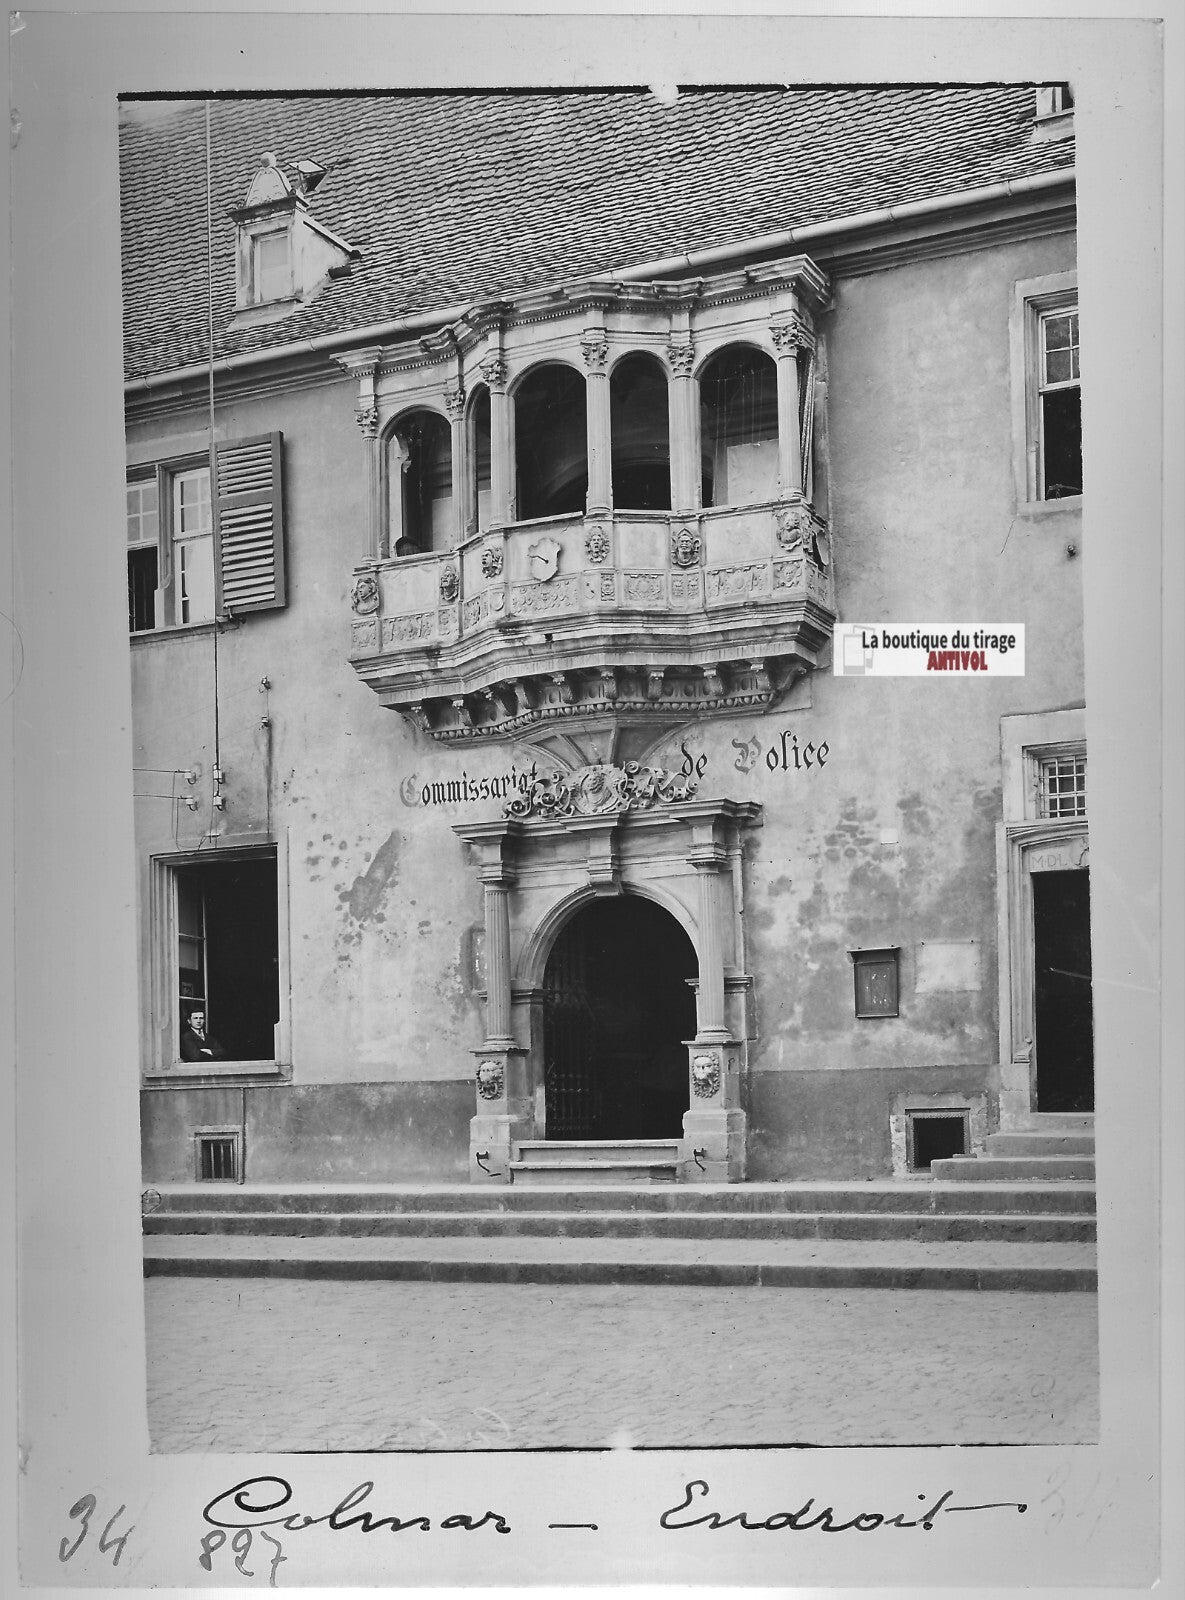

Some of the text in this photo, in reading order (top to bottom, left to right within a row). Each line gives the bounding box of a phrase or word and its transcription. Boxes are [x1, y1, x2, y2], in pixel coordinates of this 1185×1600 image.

[681, 741, 708, 779] de
[732, 730, 830, 775] Police
[58, 1493, 134, 1566] 34
[202, 1475, 512, 1534] Colmar
[660, 1479, 1028, 1533] Endroit
